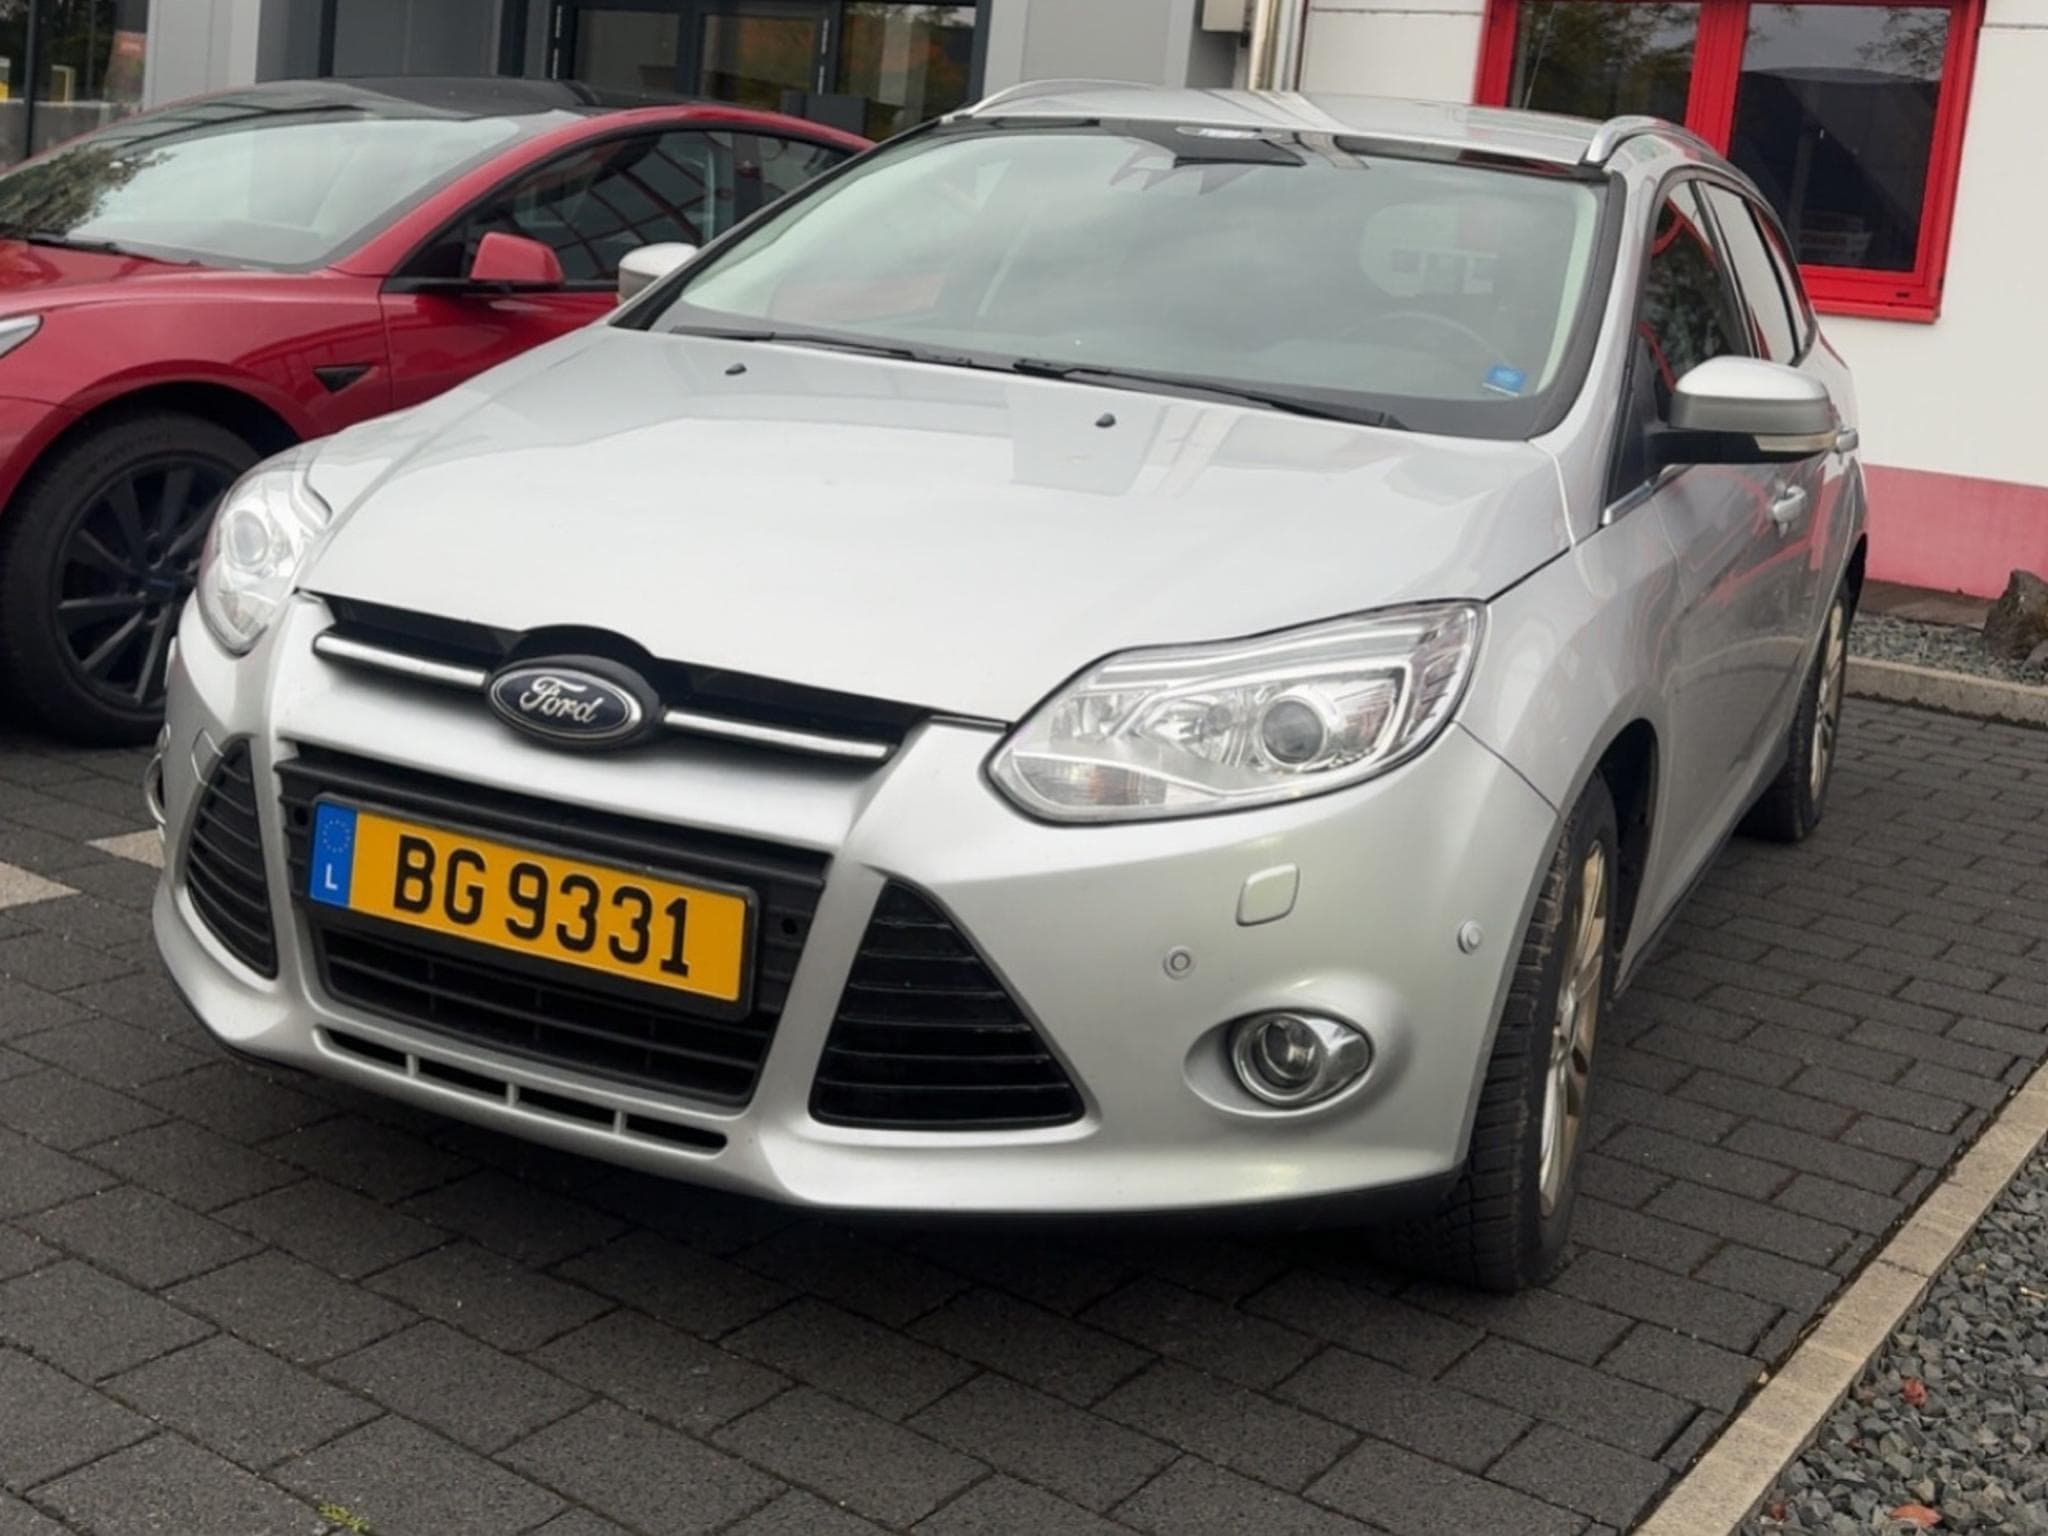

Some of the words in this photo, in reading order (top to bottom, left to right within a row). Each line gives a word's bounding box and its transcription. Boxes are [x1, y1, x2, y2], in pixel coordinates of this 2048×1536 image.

[519, 676, 604, 723] Ford
[325, 863, 338, 890] L
[394, 834, 486, 925] BG
[506, 862, 689, 978] 9331
